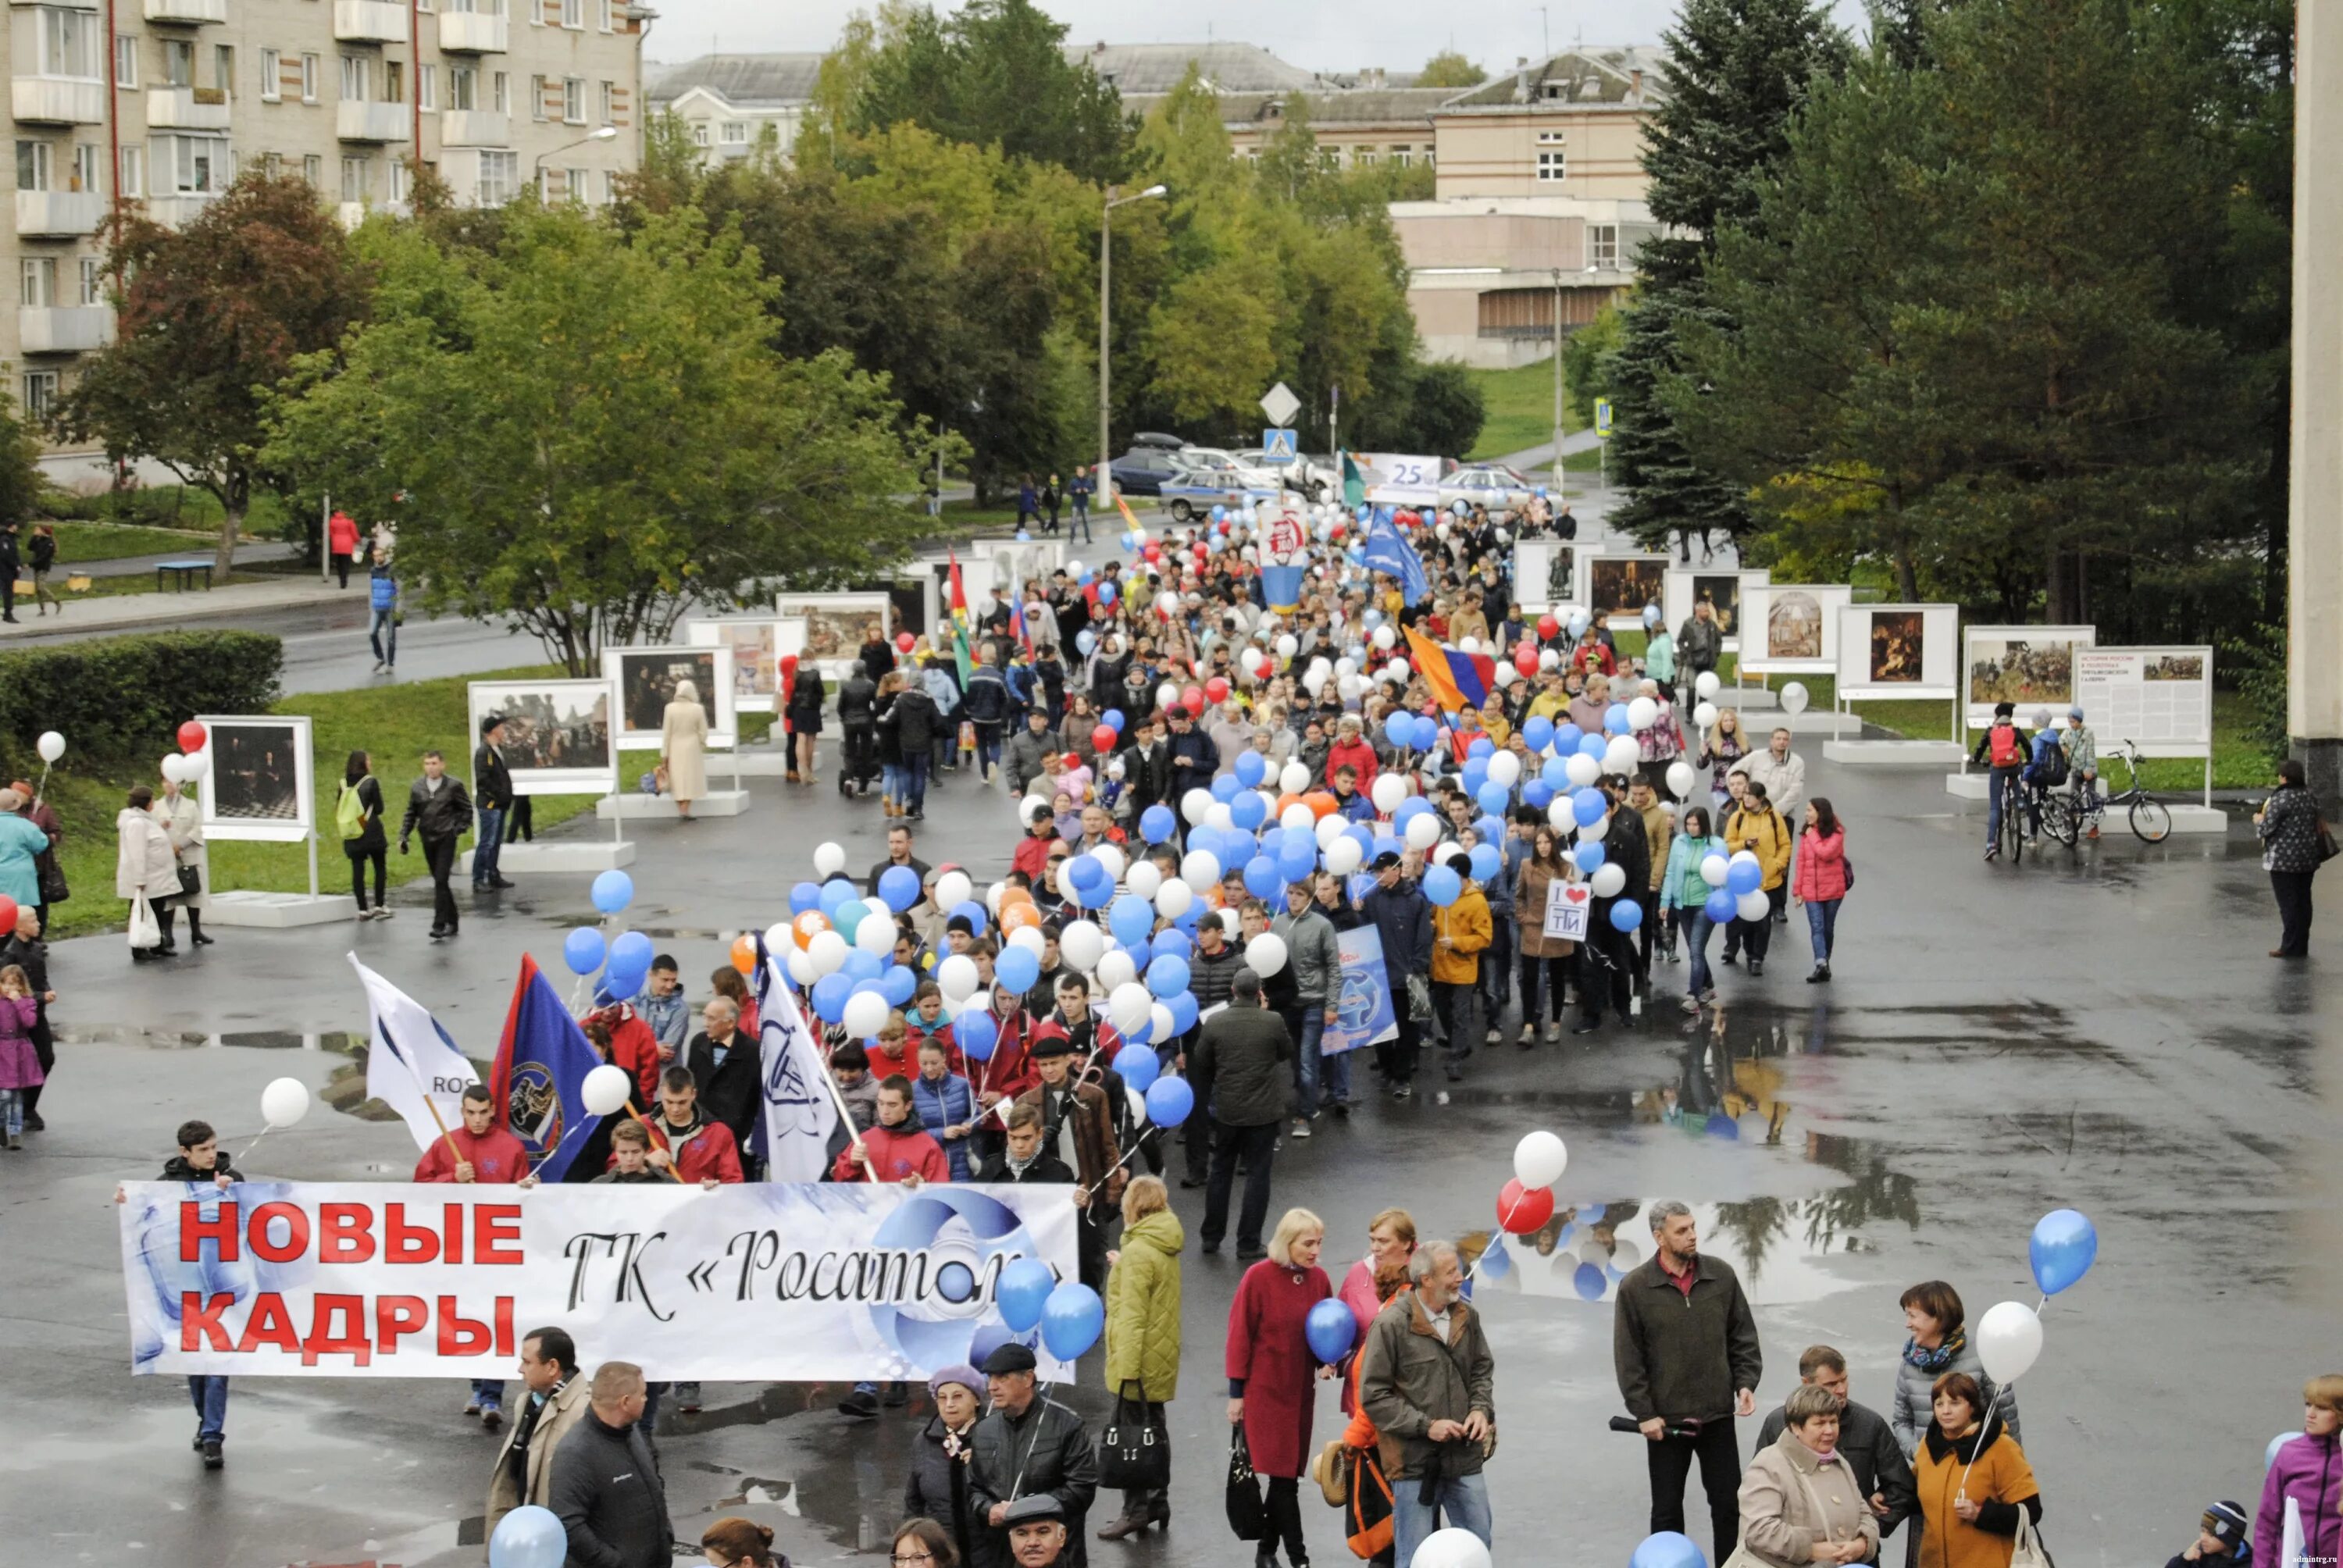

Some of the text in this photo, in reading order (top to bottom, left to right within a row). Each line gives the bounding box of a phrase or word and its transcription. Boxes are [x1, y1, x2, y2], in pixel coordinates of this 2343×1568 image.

[1393, 464, 1421, 485] 25
[180, 1200, 524, 1265] НОВЫЕ
[564, 1229, 1063, 1322] ГК «Росато
[180, 1291, 515, 1367] КАДРЫ
